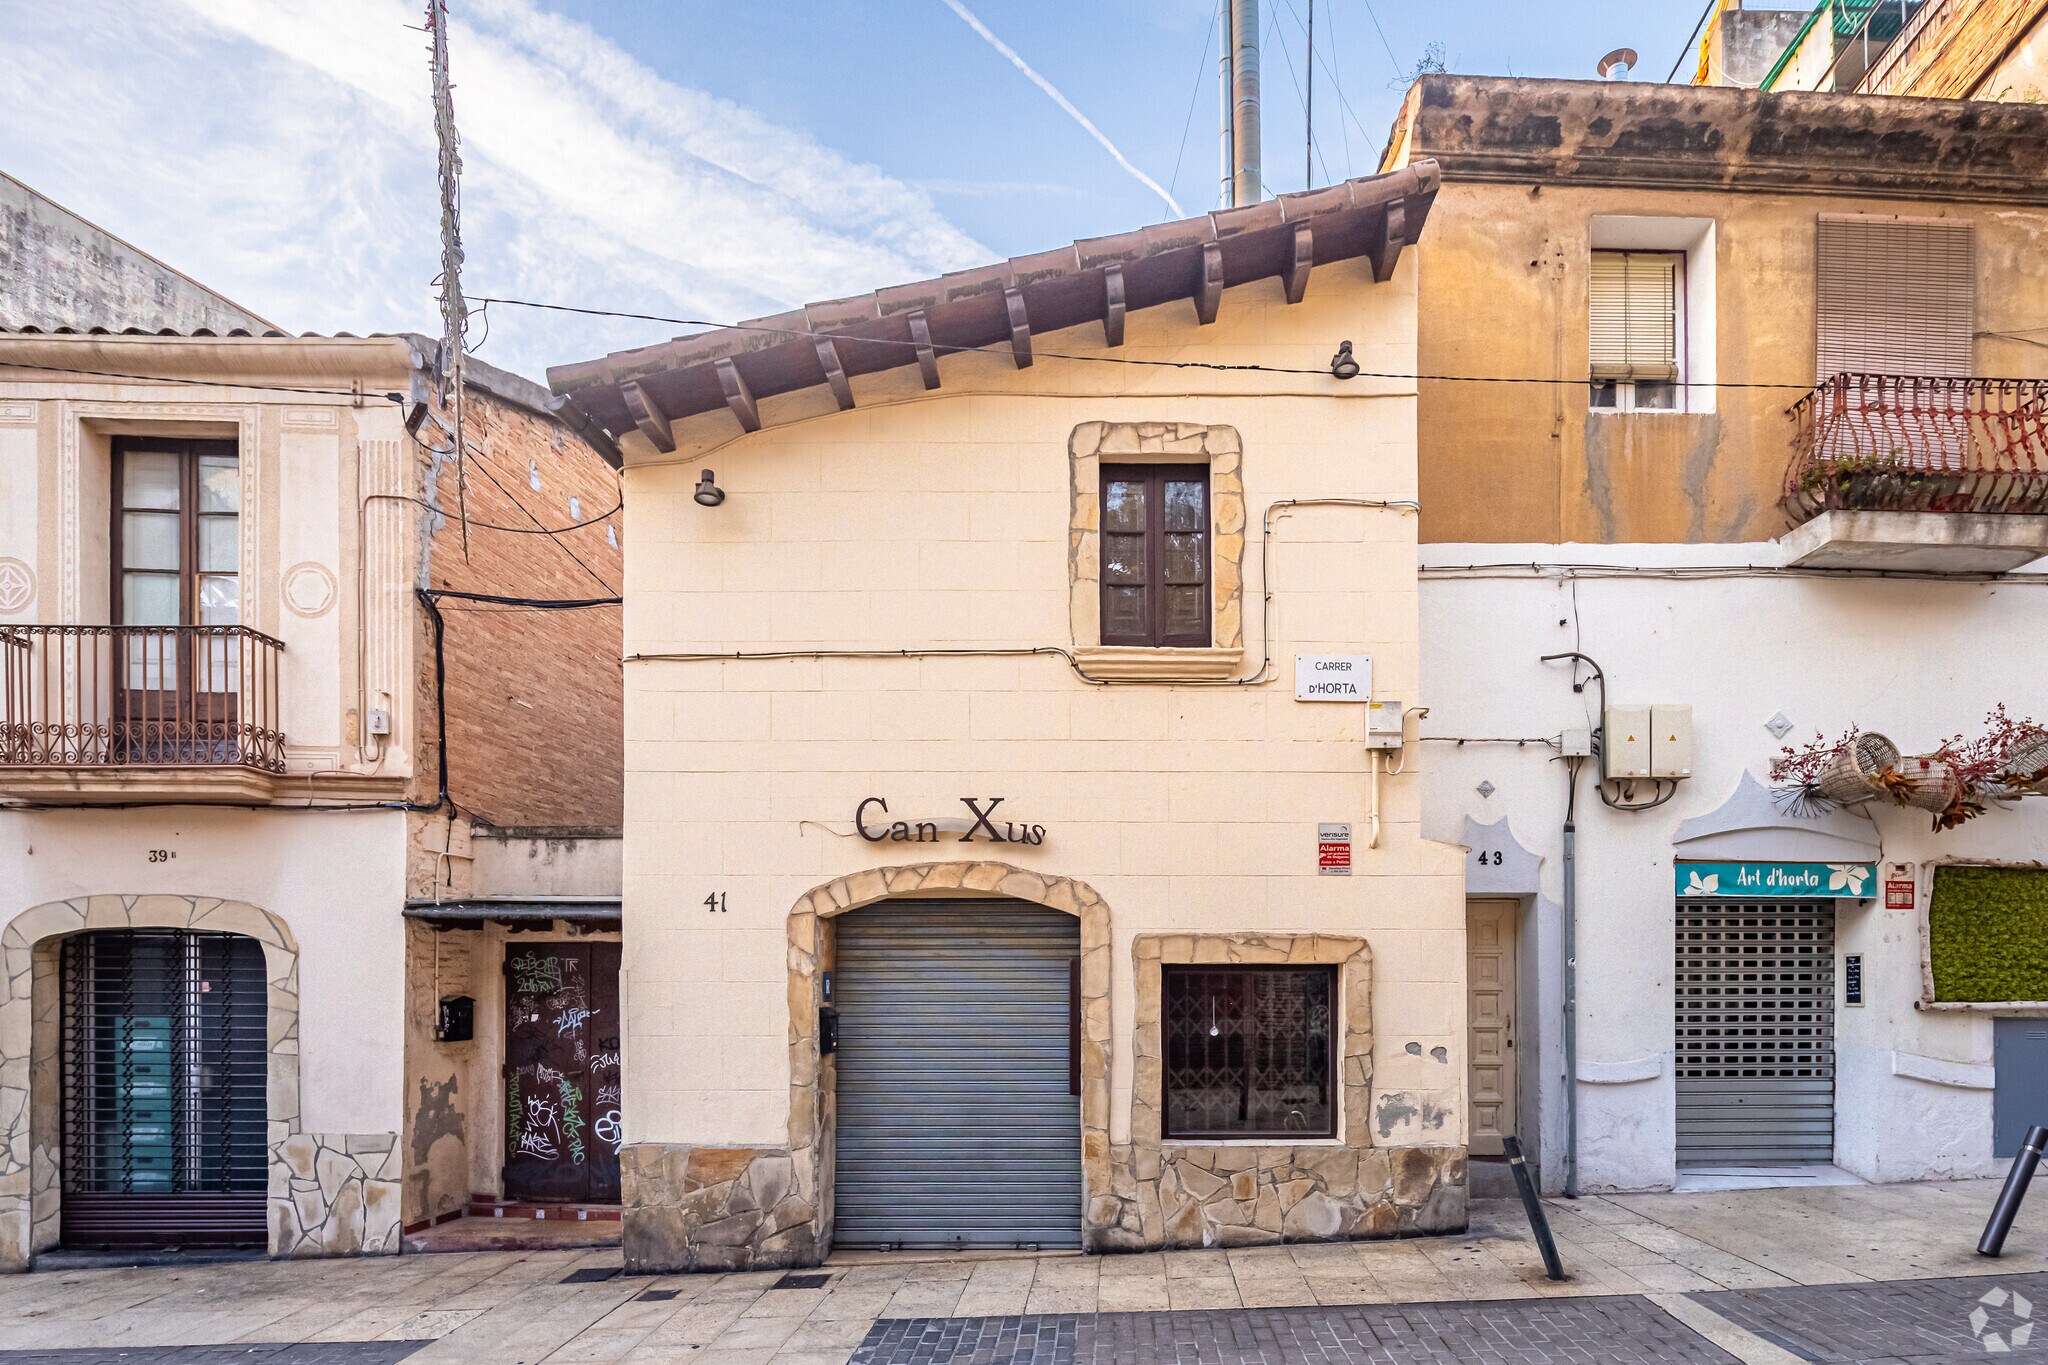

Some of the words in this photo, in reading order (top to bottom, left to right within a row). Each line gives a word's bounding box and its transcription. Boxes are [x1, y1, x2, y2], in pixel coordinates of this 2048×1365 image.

[1315, 662, 1352, 671] CARRER
[1309, 683, 1356, 694] D'HORTA
[855, 797, 939, 842] Can
[958, 797, 1046, 845] Xus
[149, 849, 168, 863] 39
[1477, 850, 1503, 866] 43
[1737, 866, 1761, 886] Art
[1766, 867, 1819, 886] d'horta
[703, 891, 727, 912] 41
